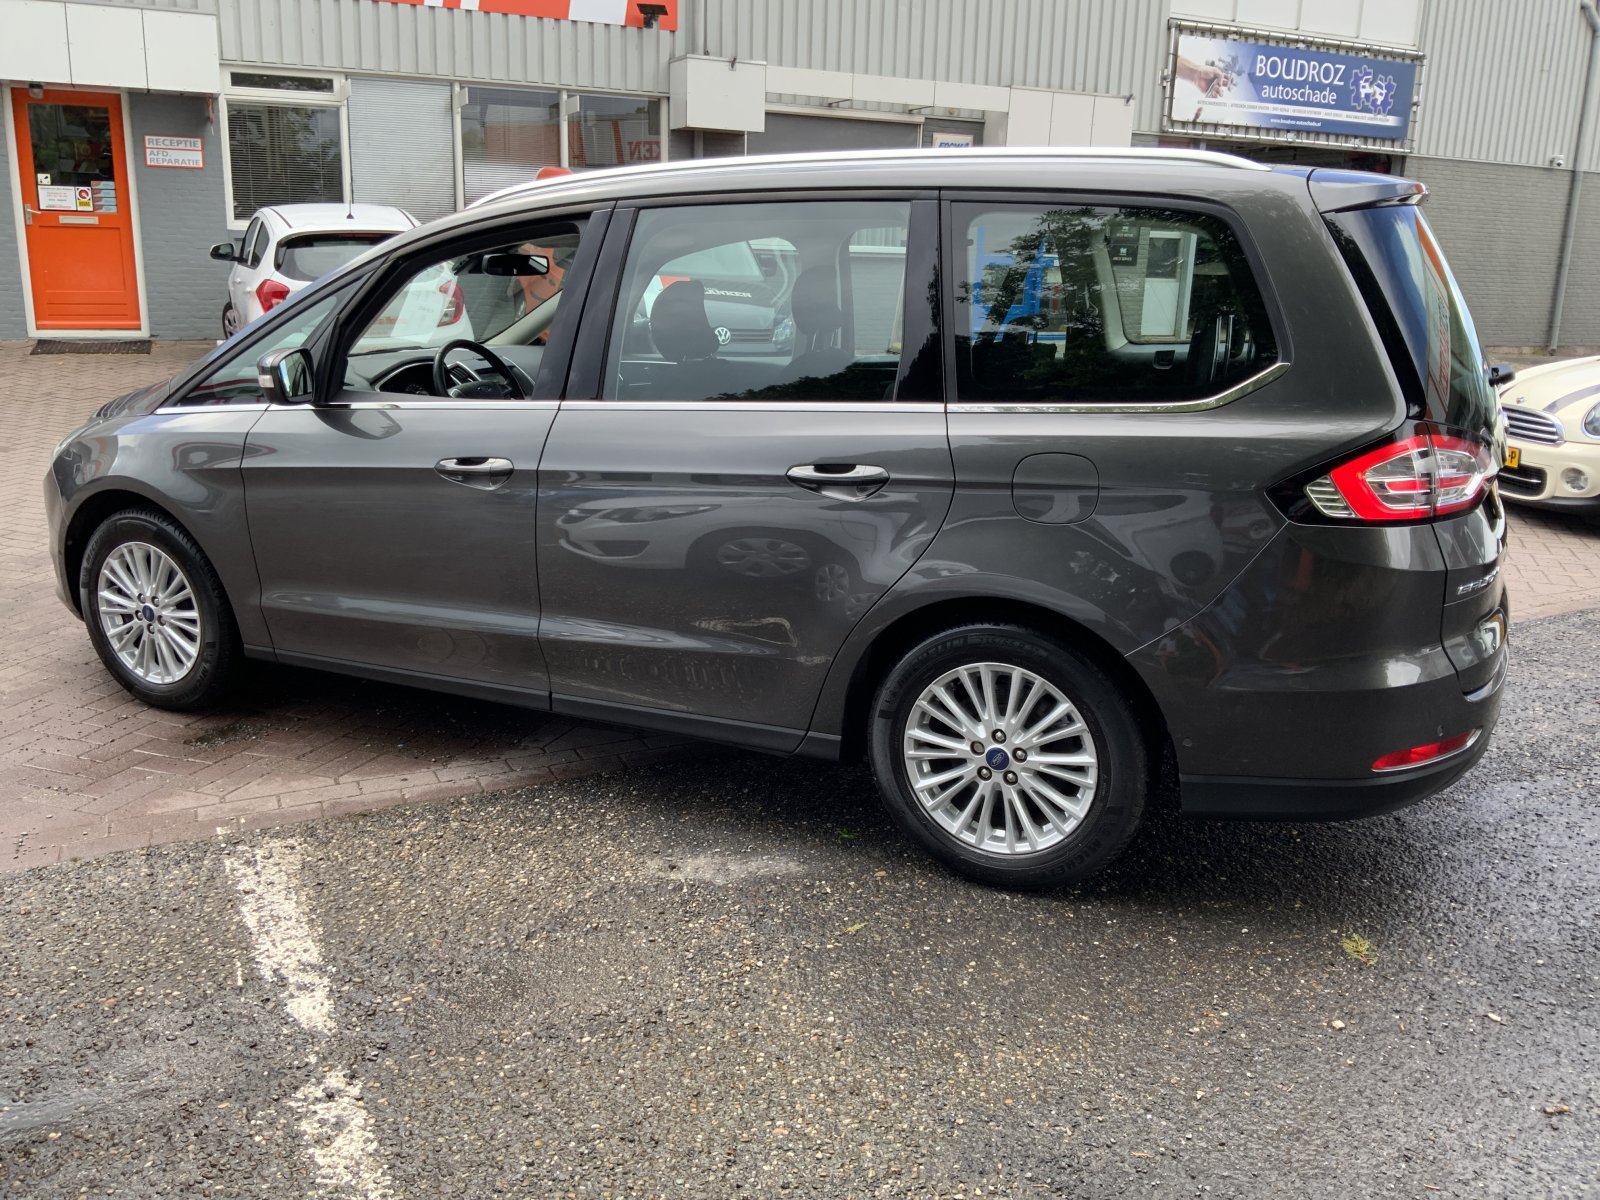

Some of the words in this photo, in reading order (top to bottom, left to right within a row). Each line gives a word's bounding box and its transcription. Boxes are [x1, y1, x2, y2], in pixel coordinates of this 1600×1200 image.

[1255, 54, 1346, 86] BOUDROZ
[1261, 84, 1337, 105] autoschade
[147, 137, 199, 148] RECEPTIE
[149, 157, 201, 166] REPARATIE
